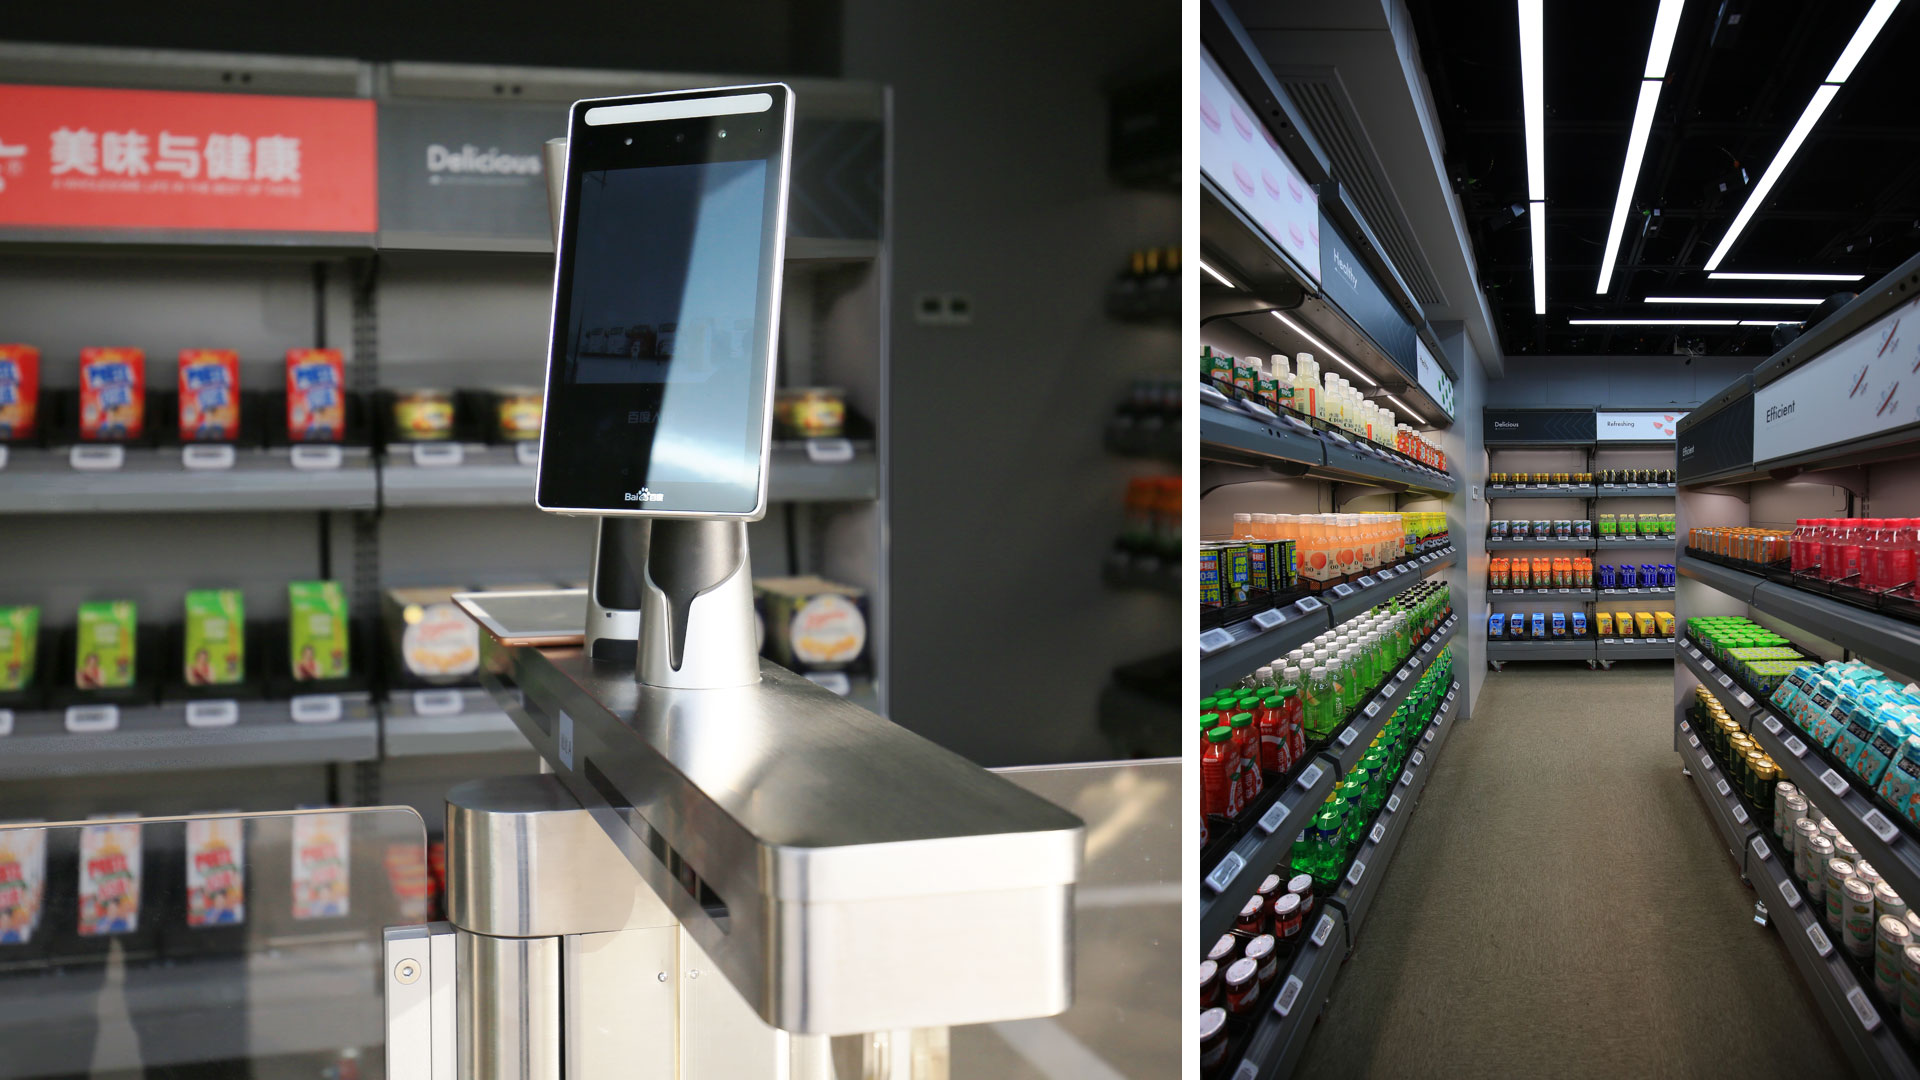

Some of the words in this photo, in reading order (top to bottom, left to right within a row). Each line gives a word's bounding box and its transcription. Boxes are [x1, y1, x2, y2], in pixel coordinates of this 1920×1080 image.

[50, 125, 301, 181] 美味与健康
[426, 144, 540, 174] Delicious
[1333, 248, 1357, 289] Healthy
[1215, 357, 1229, 369] 100%
[1237, 367, 1250, 378] 100%
[1766, 400, 1796, 424] Efficient
[1607, 421, 1635, 429] Refreshing
